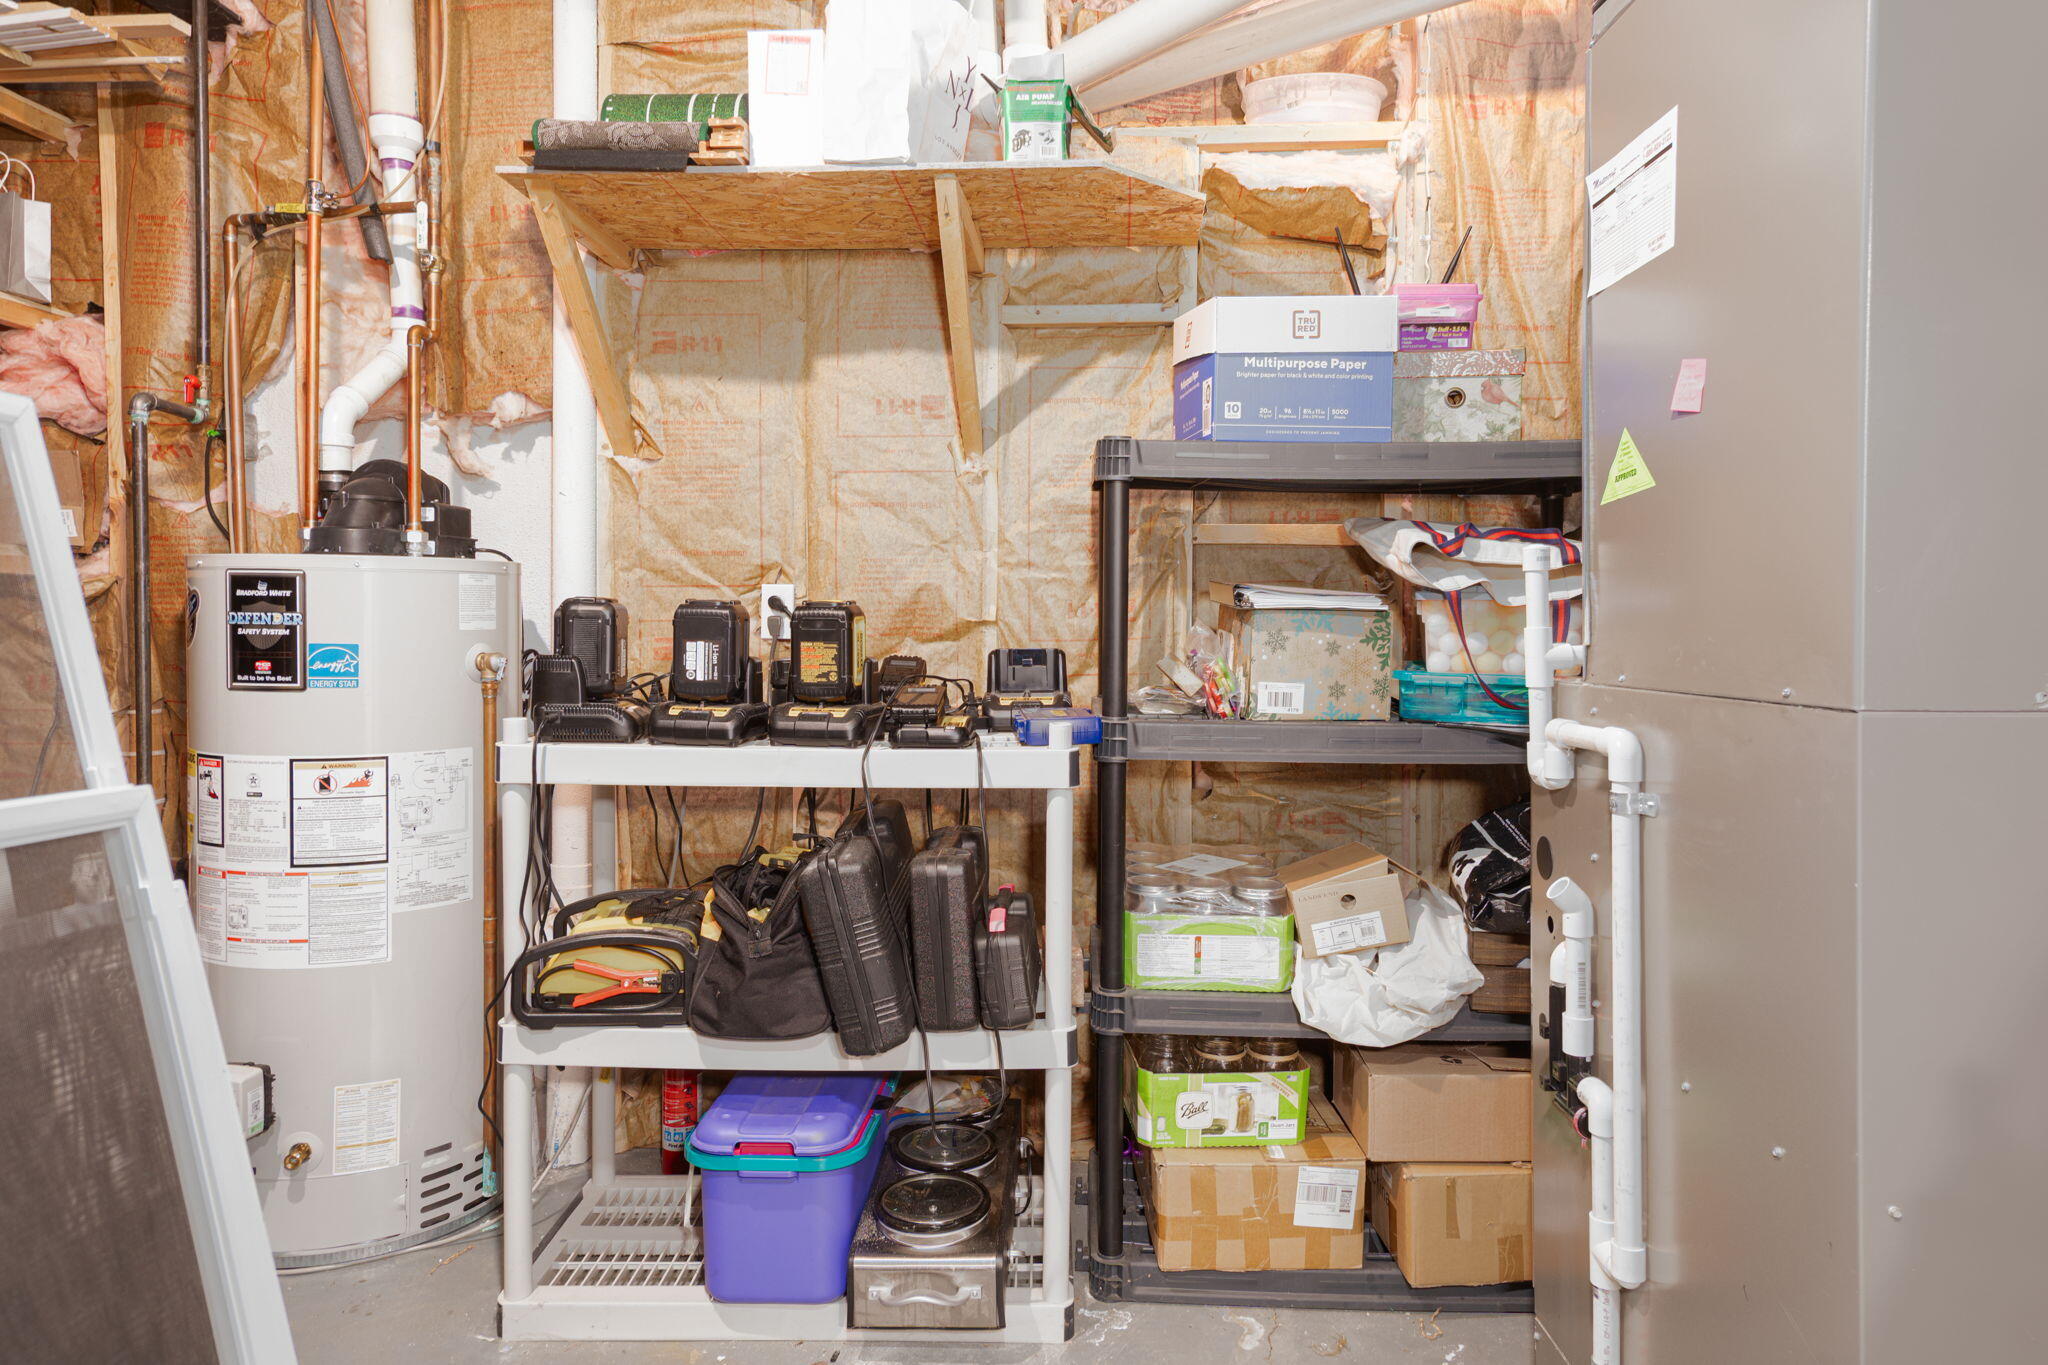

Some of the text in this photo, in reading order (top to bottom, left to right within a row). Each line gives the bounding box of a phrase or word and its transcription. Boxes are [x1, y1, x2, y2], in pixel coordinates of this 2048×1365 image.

[1031, 93, 1055, 101] PUMP
[1297, 317, 1316, 325] TRU
[1297, 325, 1316, 333] RED
[1244, 357, 1368, 372] Multipurpose Paper
[1236, 371, 1259, 380] Brighter
[1277, 371, 1286, 379] for
[1287, 371, 1302, 379] black
[1226, 404, 1239, 414] 10
[1615, 468, 1637, 483] APPROVED
[228, 612, 303, 625] DEFENDER
[310, 680, 357, 688] ENERGY STAR
[1181, 1101, 1209, 1119] Ball
